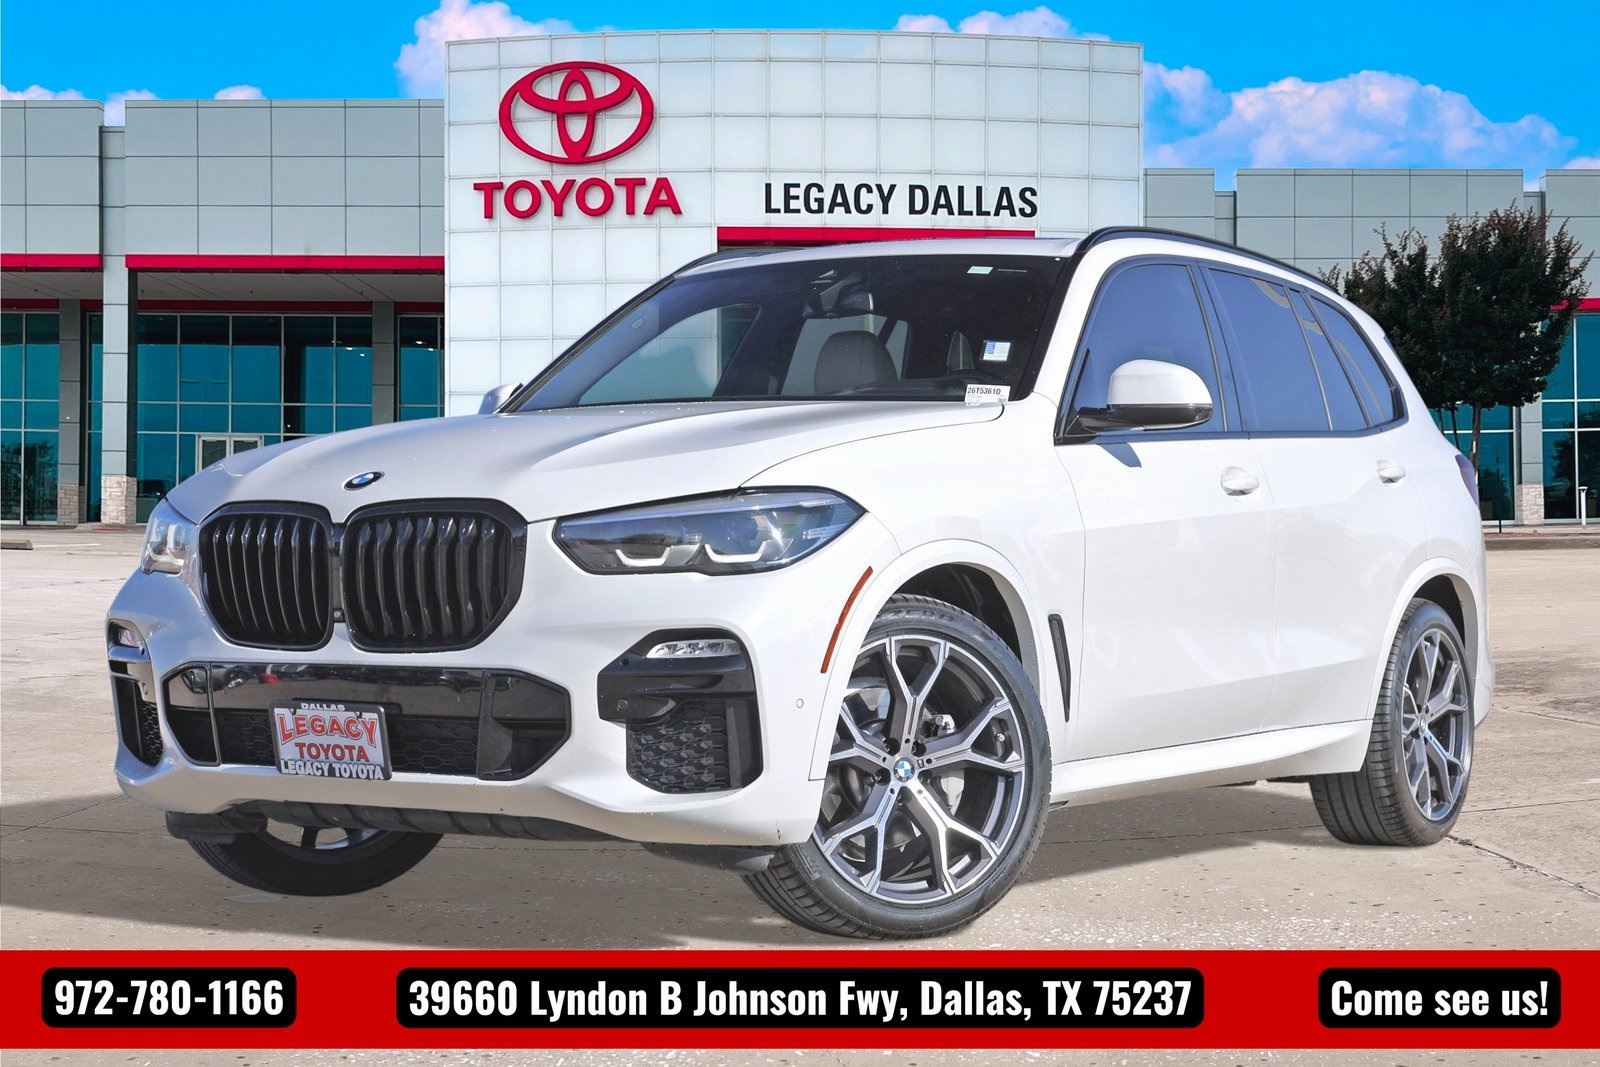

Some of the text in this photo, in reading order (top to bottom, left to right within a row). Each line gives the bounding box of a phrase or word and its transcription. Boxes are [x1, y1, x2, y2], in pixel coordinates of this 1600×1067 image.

[473, 177, 682, 219] TOYOTA
[764, 182, 1038, 218] LEGACY DALLAS
[300, 703, 346, 711] DALLAS
[277, 713, 377, 748] LEGACY
[294, 742, 370, 762] TOYOTA
[280, 759, 384, 780] LEGACY TOYOTA
